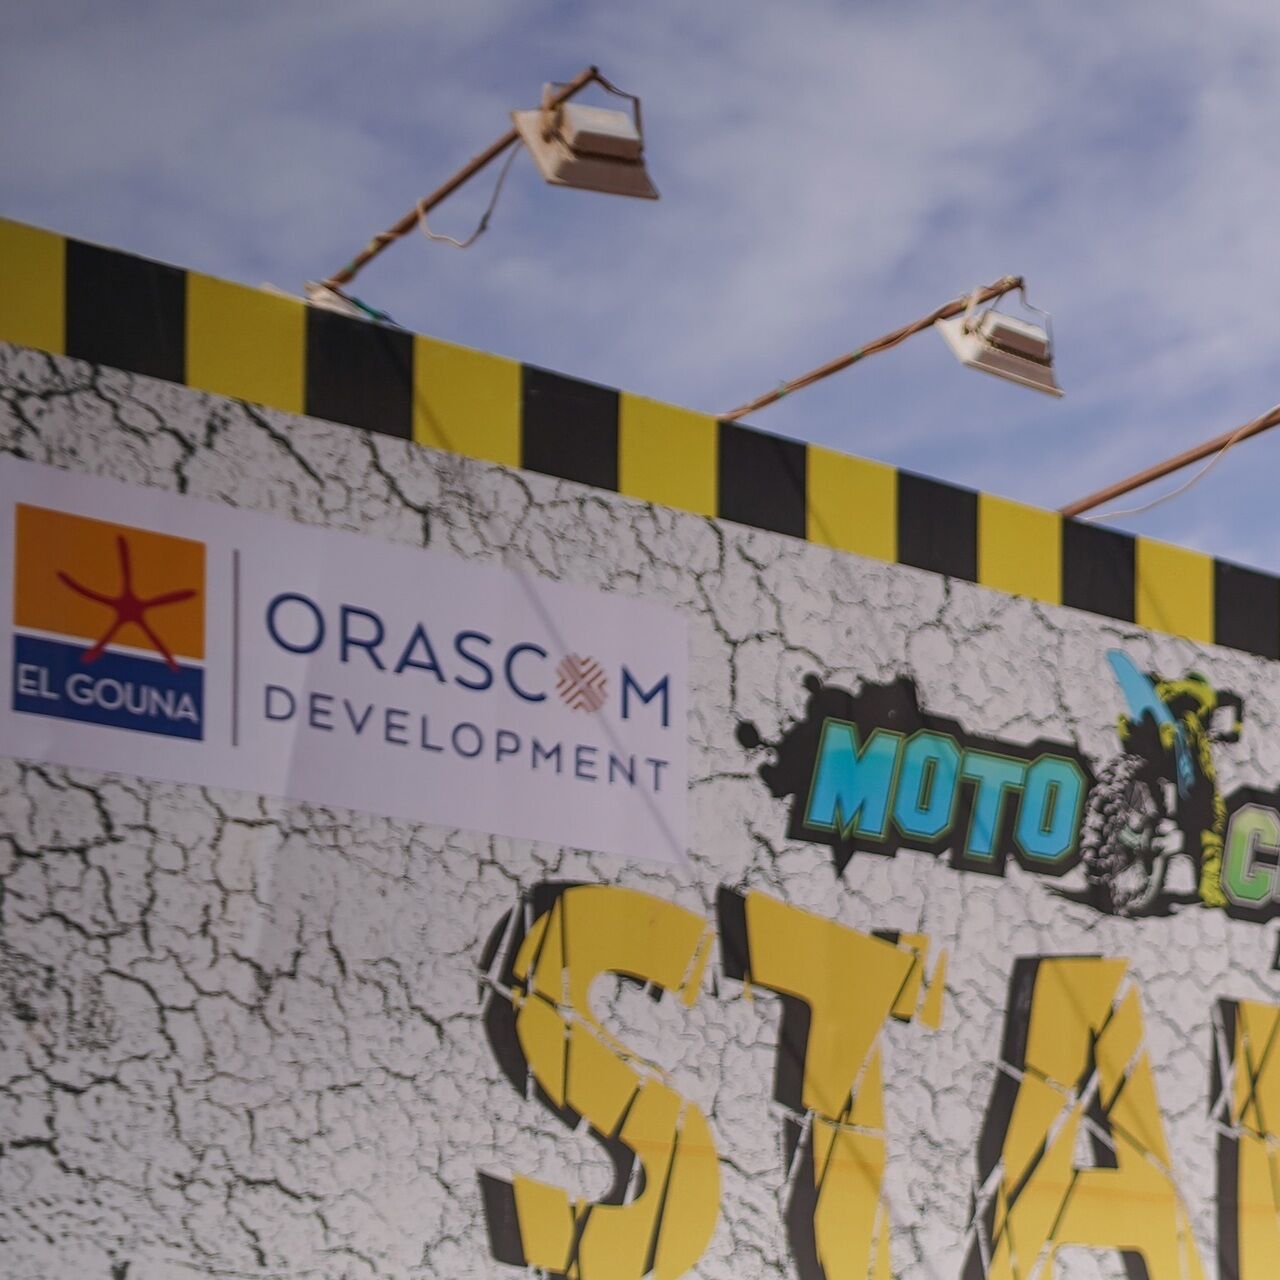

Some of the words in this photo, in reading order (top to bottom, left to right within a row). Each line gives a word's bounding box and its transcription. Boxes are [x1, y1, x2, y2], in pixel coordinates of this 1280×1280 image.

[17, 662, 59, 702] EL
[64, 672, 199, 724] GOUNA
[264, 684, 670, 793] DEVELOPMENT
[803, 715, 1087, 863] MOTO
